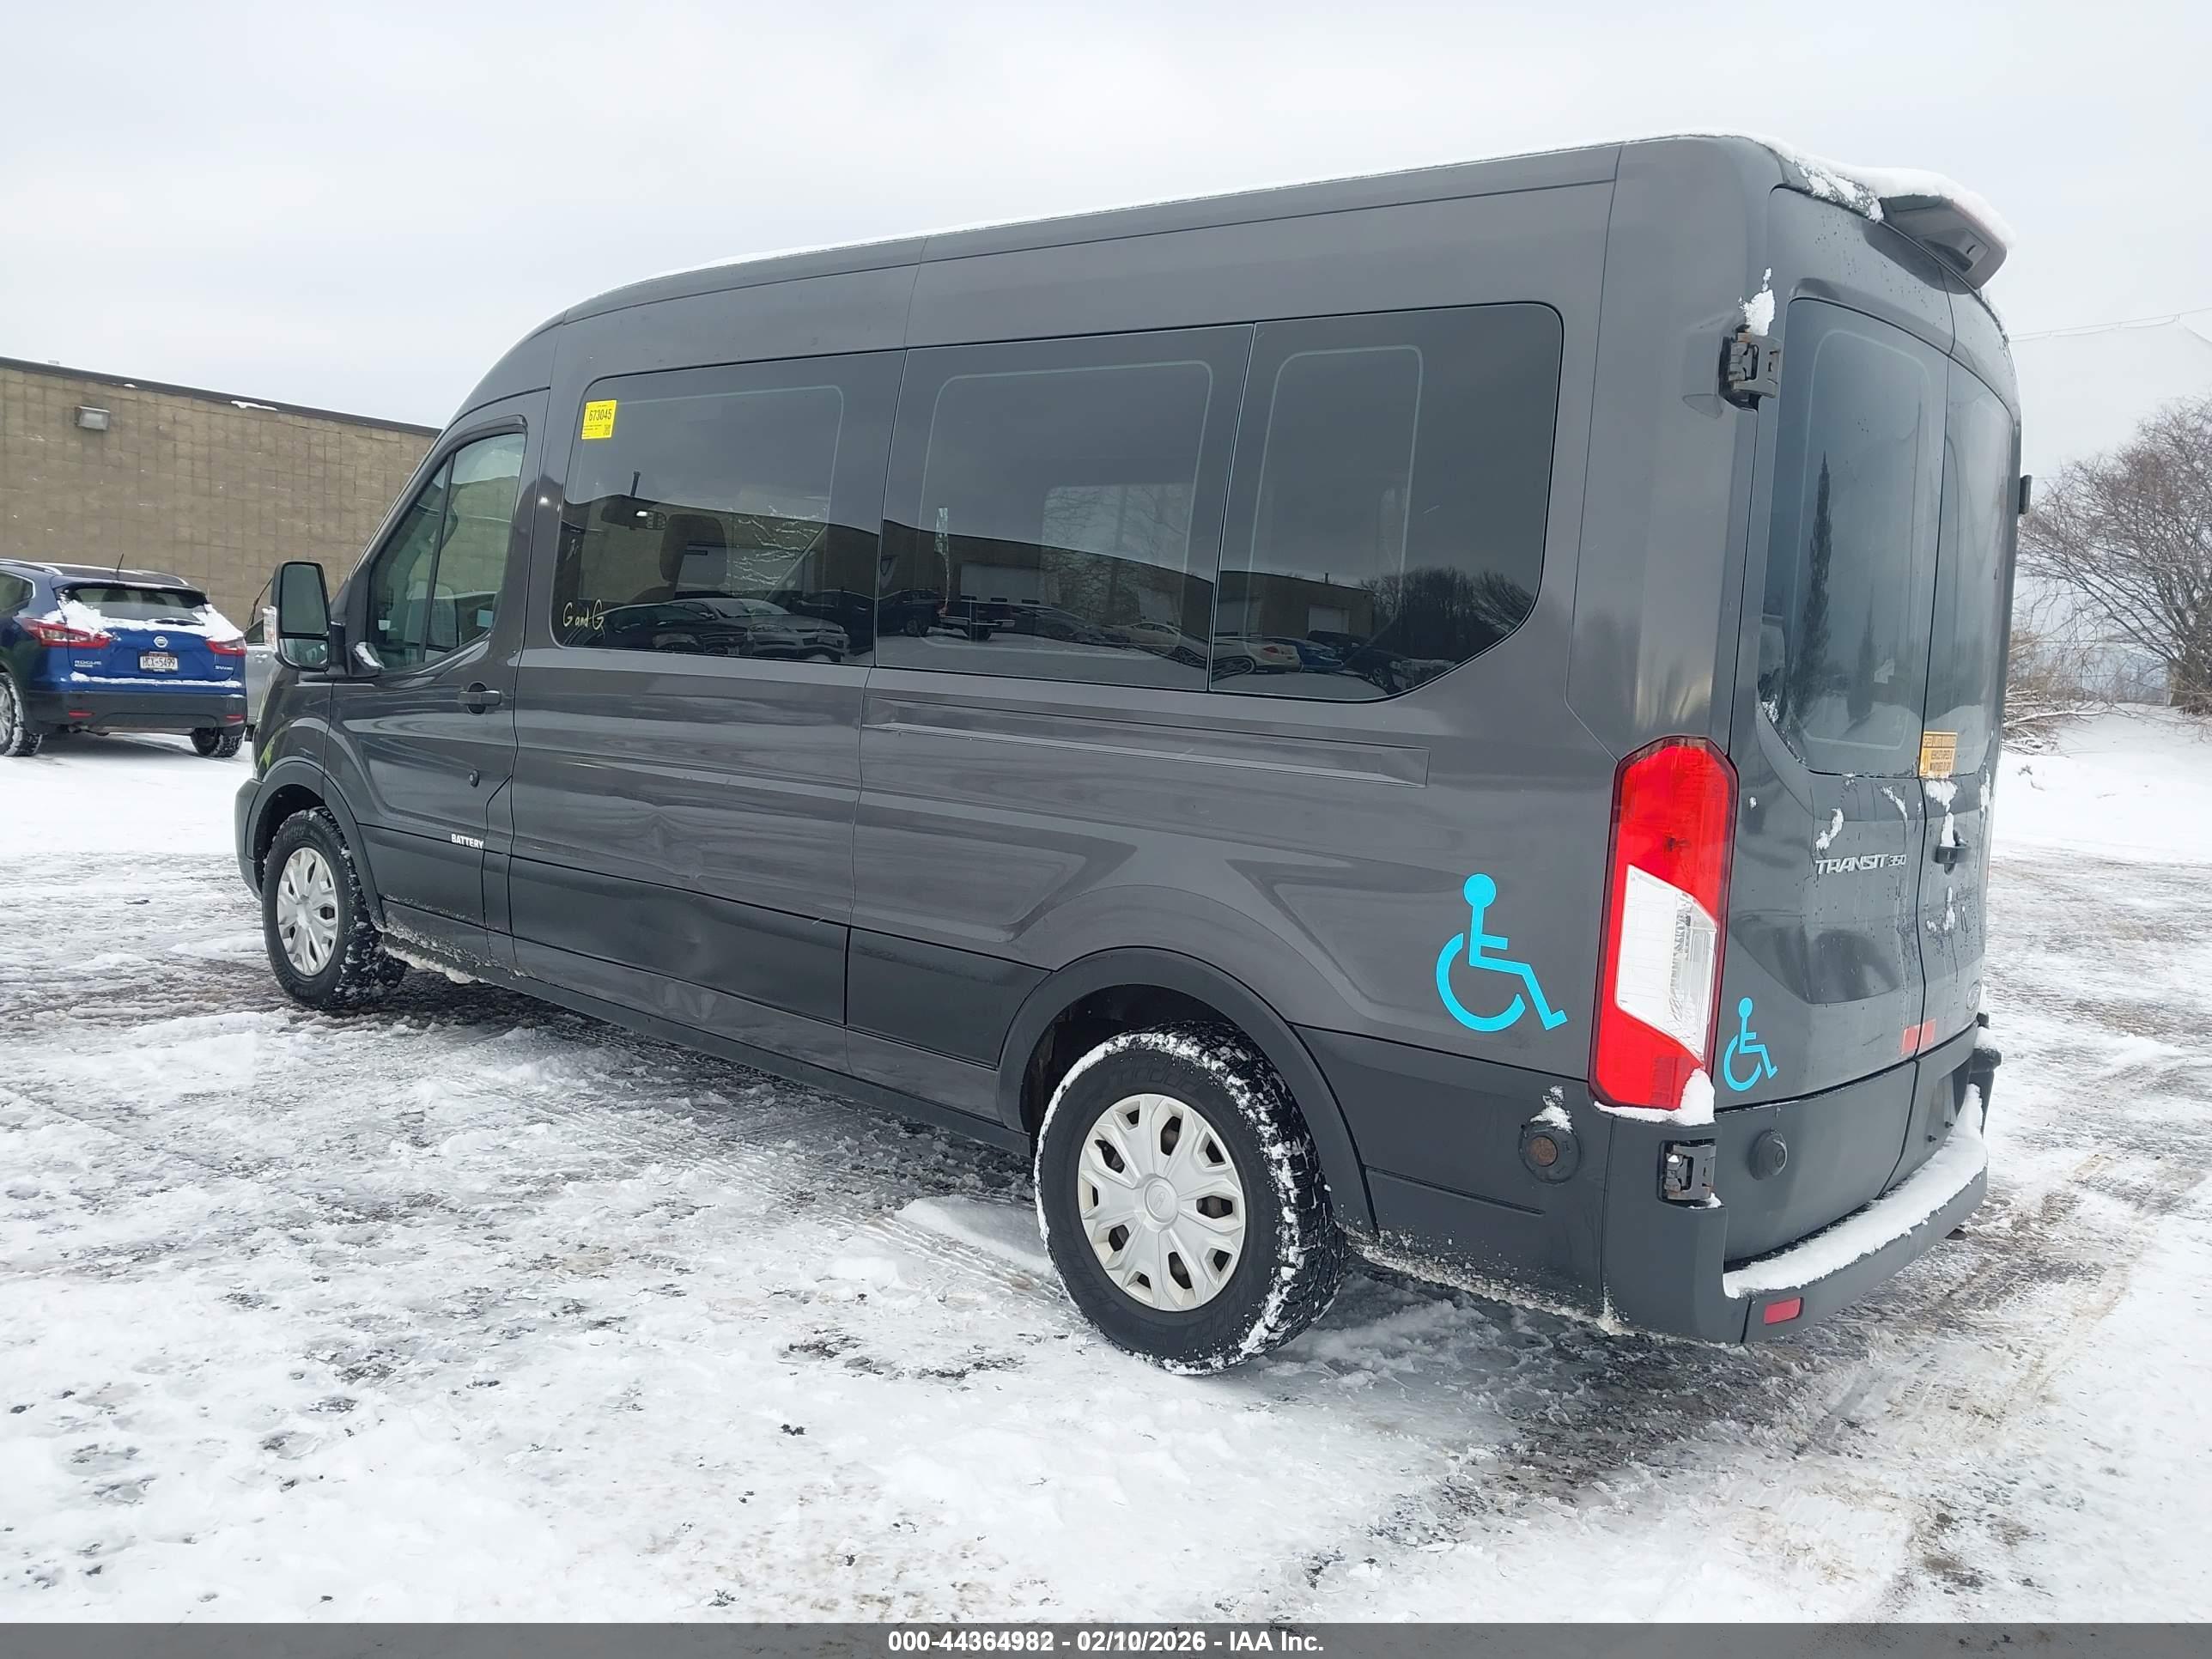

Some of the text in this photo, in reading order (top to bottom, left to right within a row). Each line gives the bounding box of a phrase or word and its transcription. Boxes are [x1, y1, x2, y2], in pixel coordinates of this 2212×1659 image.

[588, 409, 612, 422] 673045
[562, 599, 604, 629] G and G
[451, 834, 483, 849] BATTERY
[1815, 854, 1907, 874] TRANSIT 350
